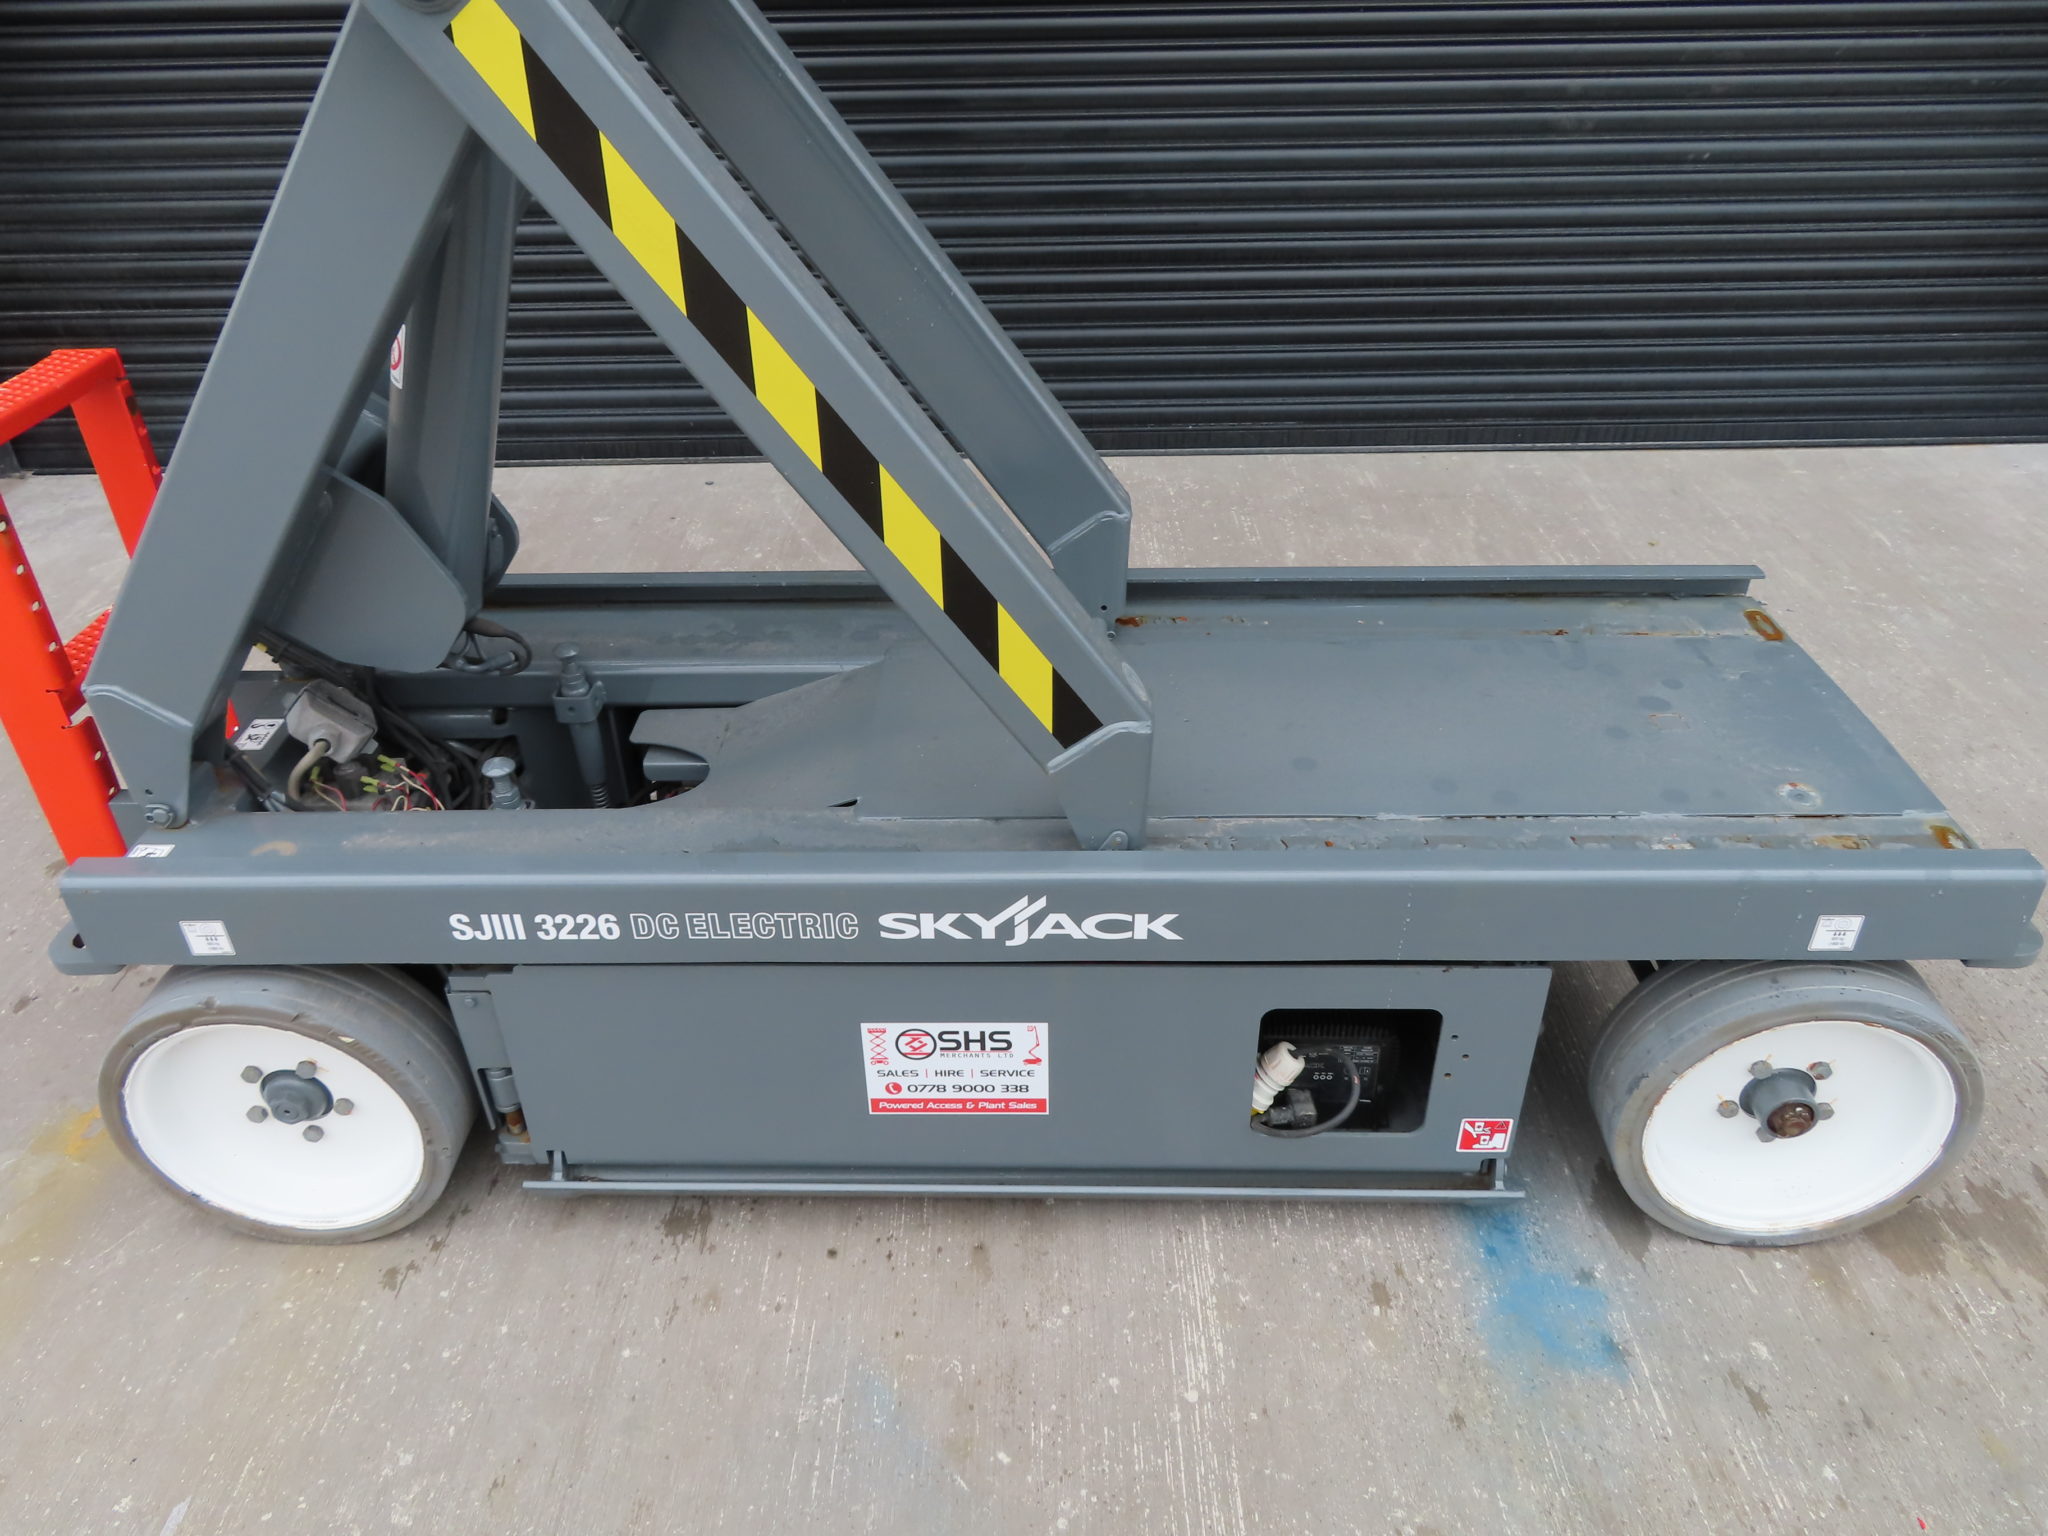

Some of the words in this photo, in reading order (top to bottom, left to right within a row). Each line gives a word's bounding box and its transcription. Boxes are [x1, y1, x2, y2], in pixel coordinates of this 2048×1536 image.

[534, 913, 621, 941] 3226
[629, 913, 680, 940] DC
[685, 912, 859, 940] ELECTRIC
[877, 895, 1184, 946] SKYJACK
[937, 1030, 1013, 1051] SHS
[876, 1069, 919, 1078] SALES
[934, 1069, 965, 1078] HIRE
[979, 1069, 1036, 1078] SERVICE
[907, 1084, 947, 1093] 0778
[952, 1084, 996, 1093] 9000
[1000, 1084, 1030, 1093] 338
[879, 1101, 924, 1110] Powered
[926, 1101, 963, 1110] Access
[965, 1101, 975, 1110] &
[978, 1101, 1006, 1110] Plant
[1008, 1101, 1038, 1110] Sales
